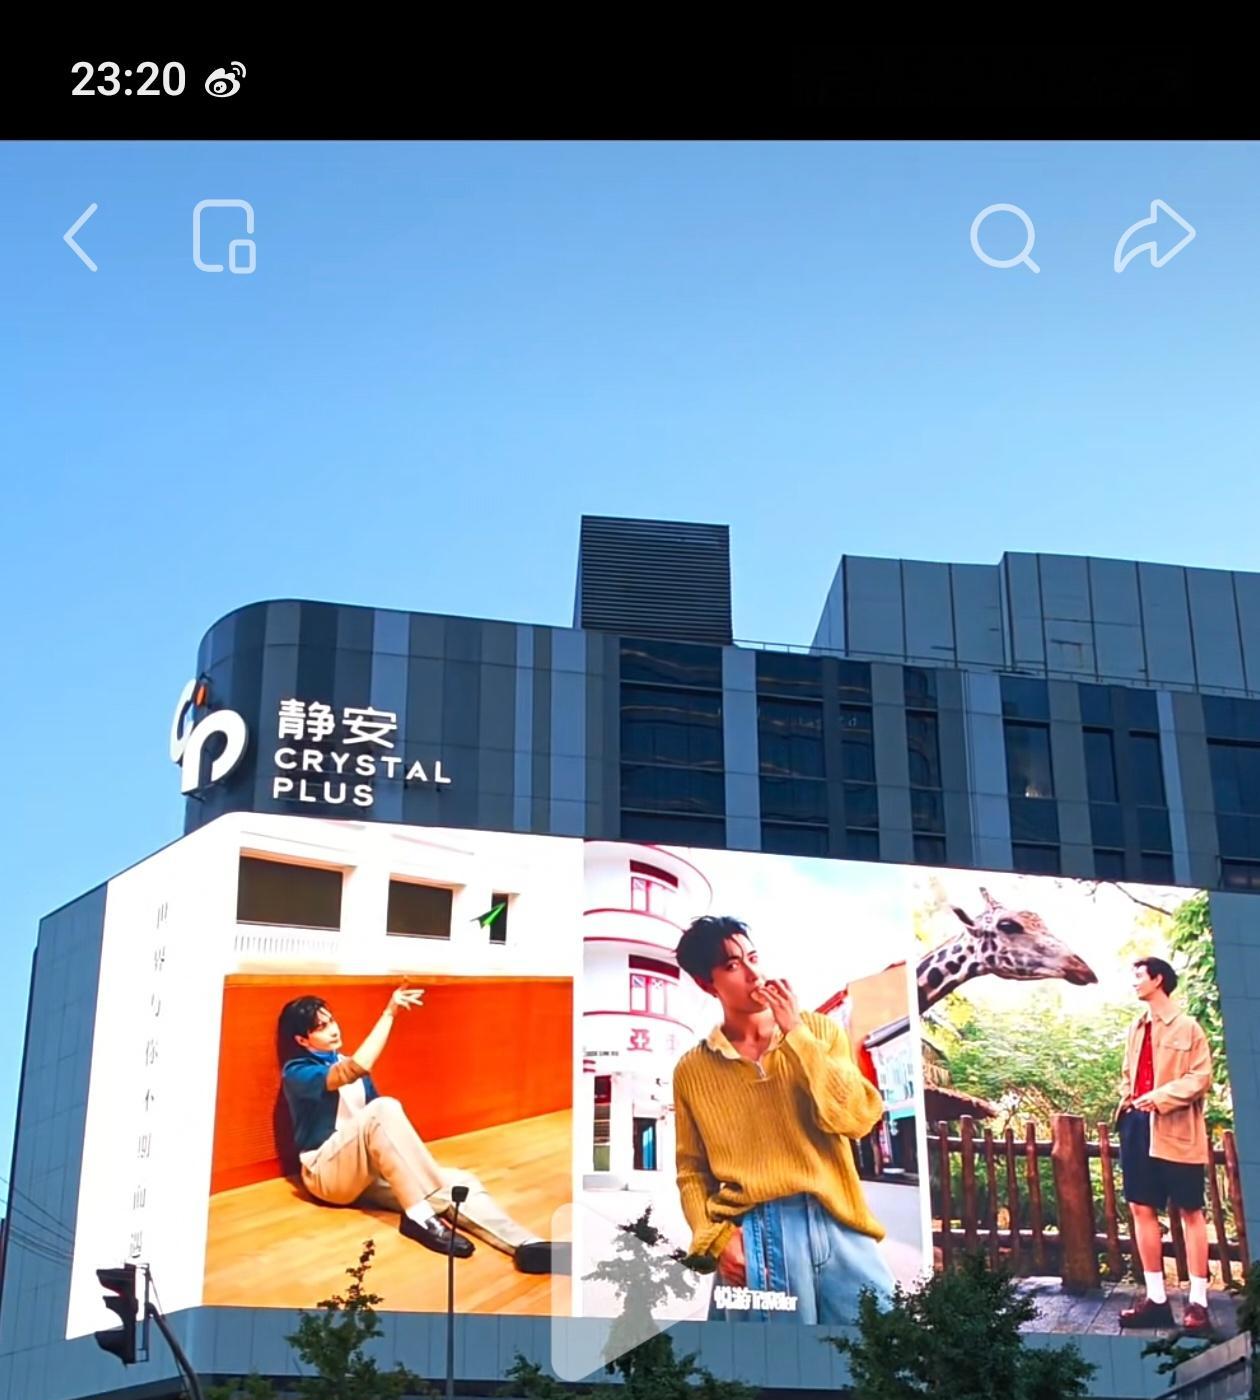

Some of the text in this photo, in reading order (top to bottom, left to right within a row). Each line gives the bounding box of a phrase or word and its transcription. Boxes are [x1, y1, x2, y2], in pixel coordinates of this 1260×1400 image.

[278, 698, 398, 749] 静安
[274, 748, 453, 784] CRYSTAL
[272, 776, 374, 807] PLUS
